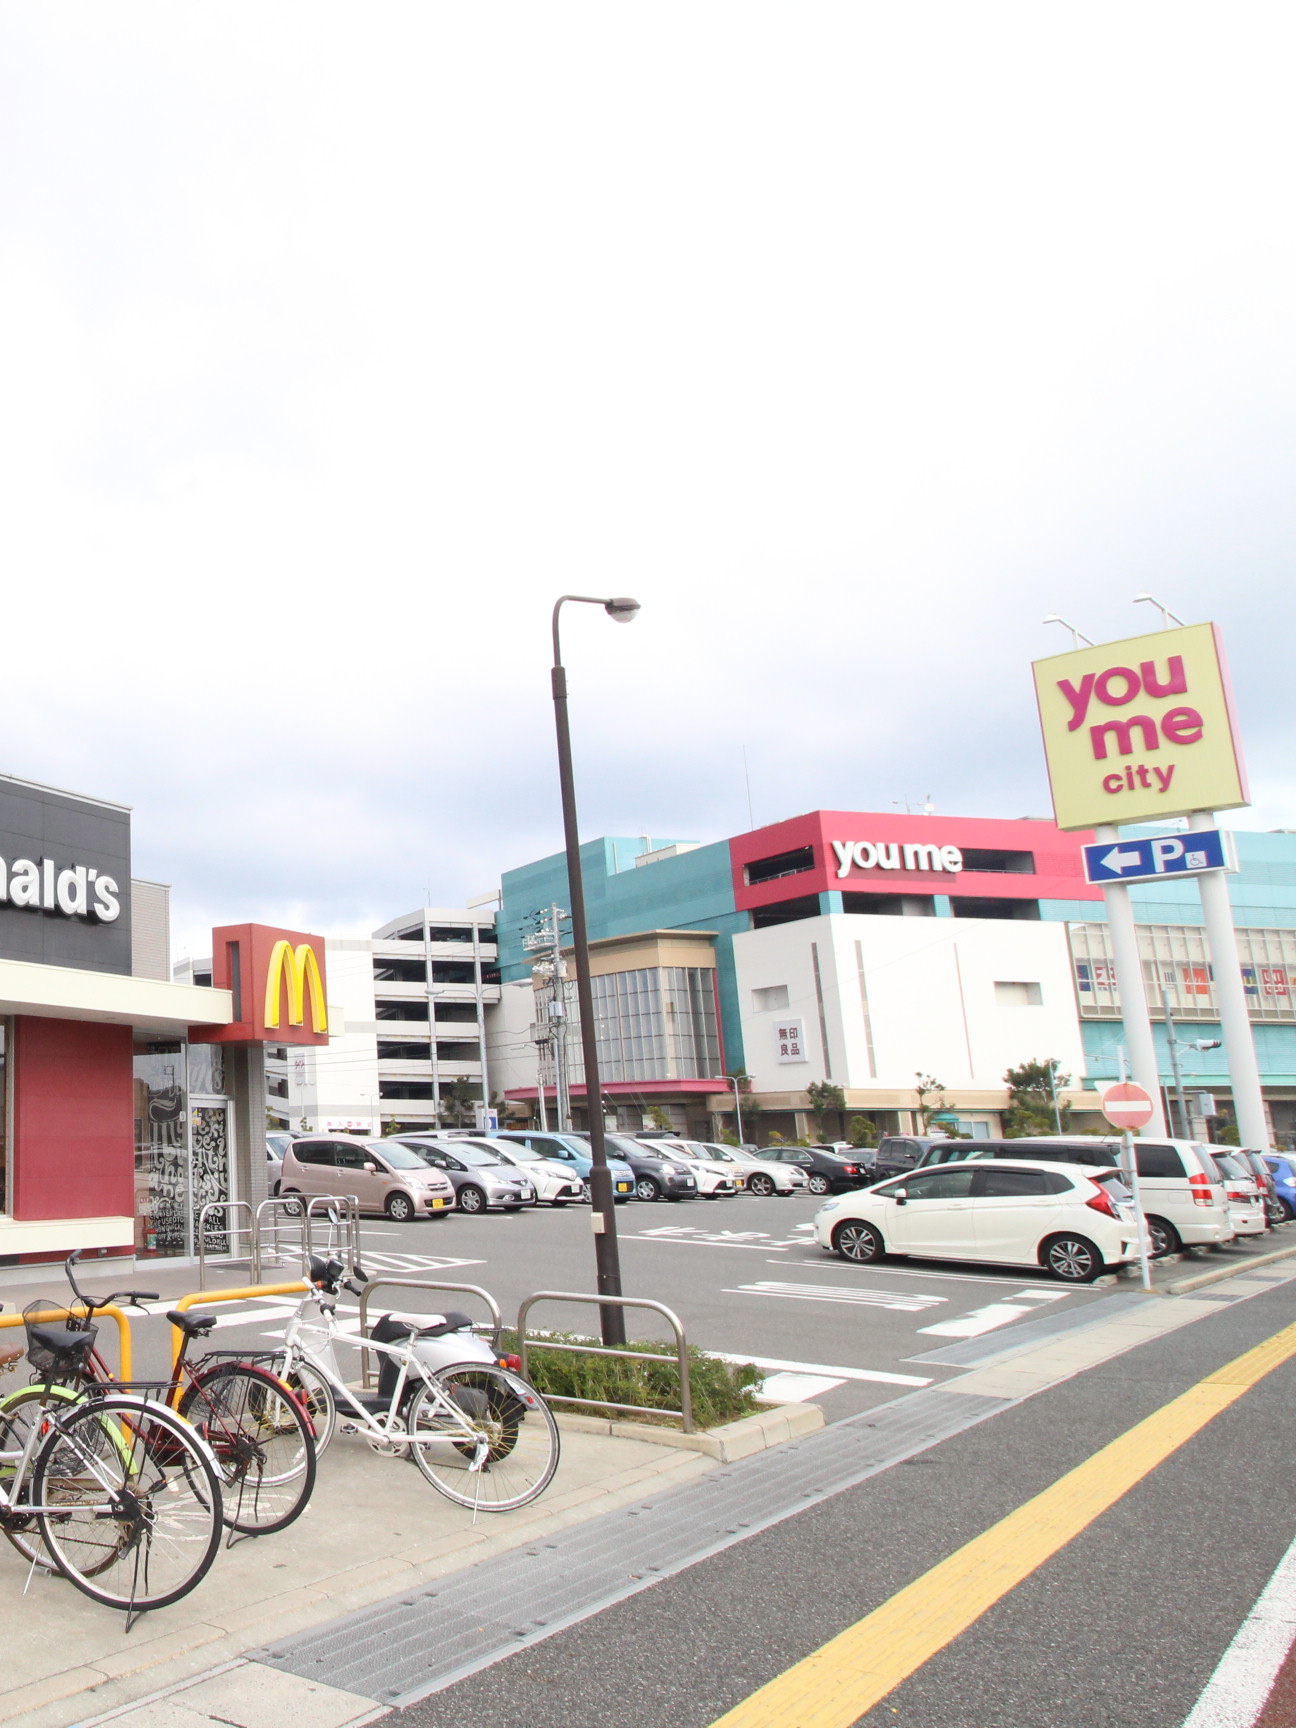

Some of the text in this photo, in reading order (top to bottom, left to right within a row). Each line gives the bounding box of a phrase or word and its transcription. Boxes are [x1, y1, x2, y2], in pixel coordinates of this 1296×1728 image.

[1056, 654, 1188, 732] you
[1088, 706, 1204, 760] me
[1102, 763, 1176, 794] city
[1152, 838, 1185, 873] P
[778, 1027, 799, 1041] 無印
[780, 1042, 801, 1057] 良品
